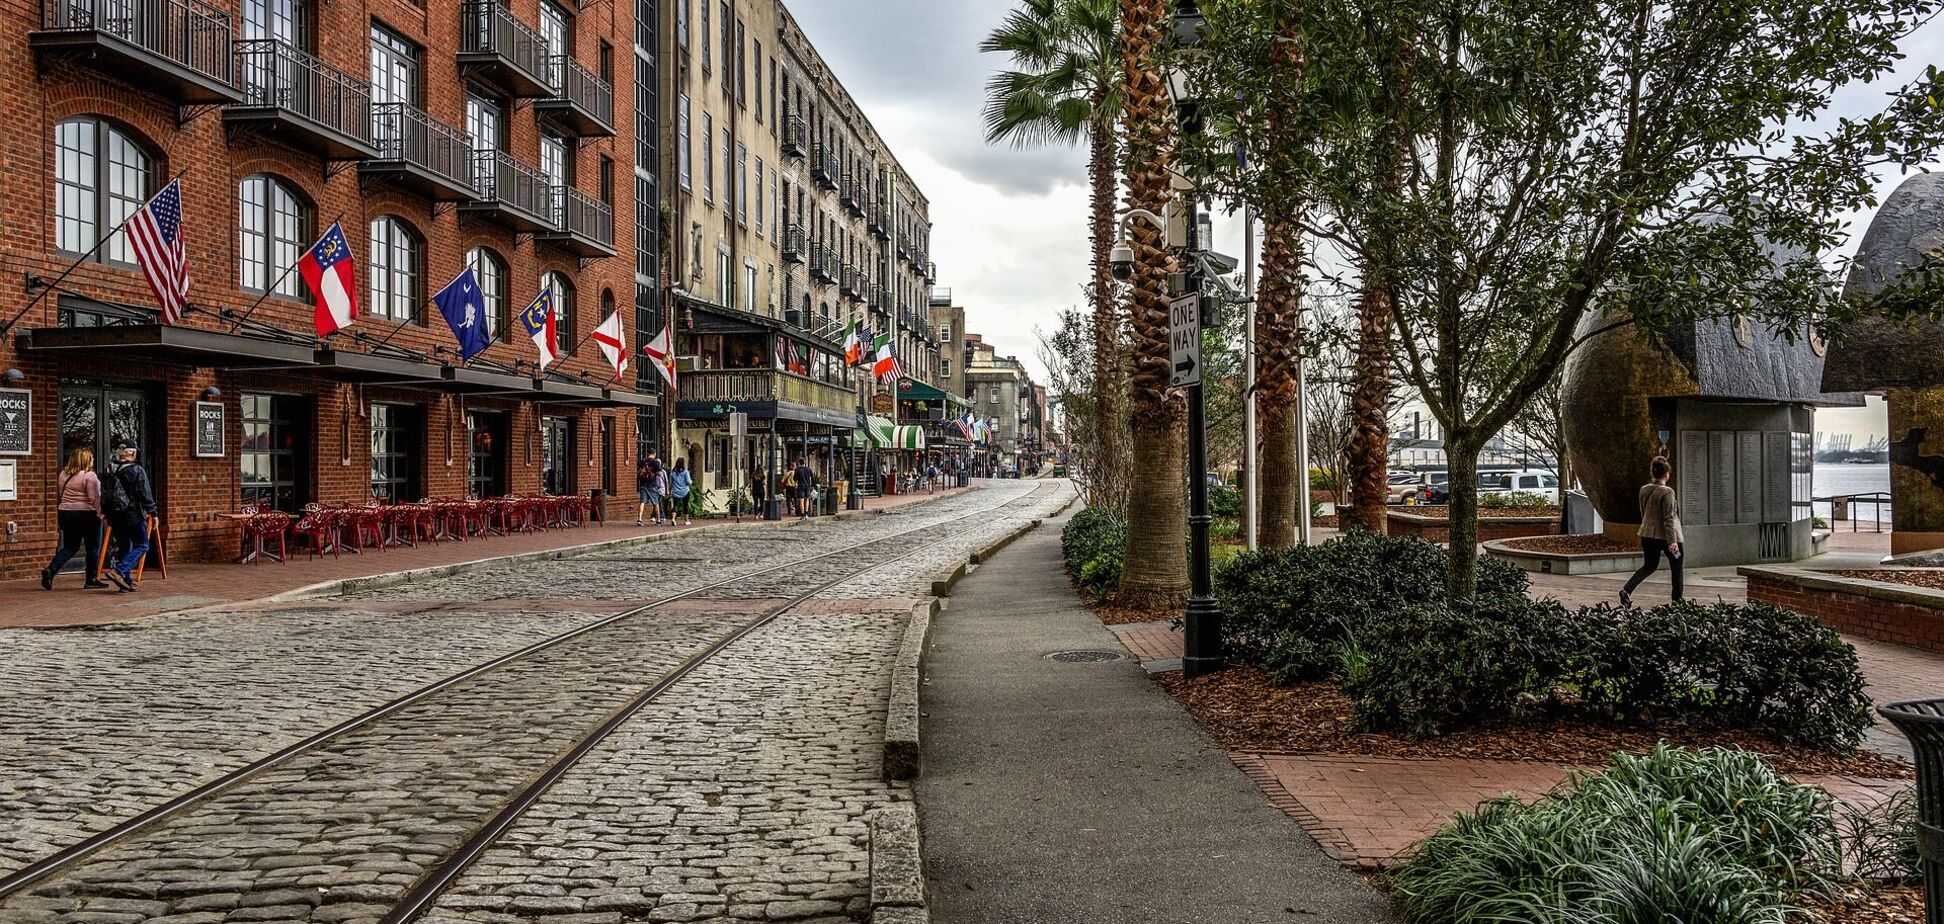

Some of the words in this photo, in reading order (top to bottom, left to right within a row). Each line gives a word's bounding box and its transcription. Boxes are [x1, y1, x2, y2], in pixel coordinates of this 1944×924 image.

[1172, 302, 1195, 327] ONE
[1173, 326, 1196, 352] WAY
[0, 399, 27, 410] OCKS
[200, 410, 221, 419] ROCKS
[682, 420, 708, 428] KEVIN
